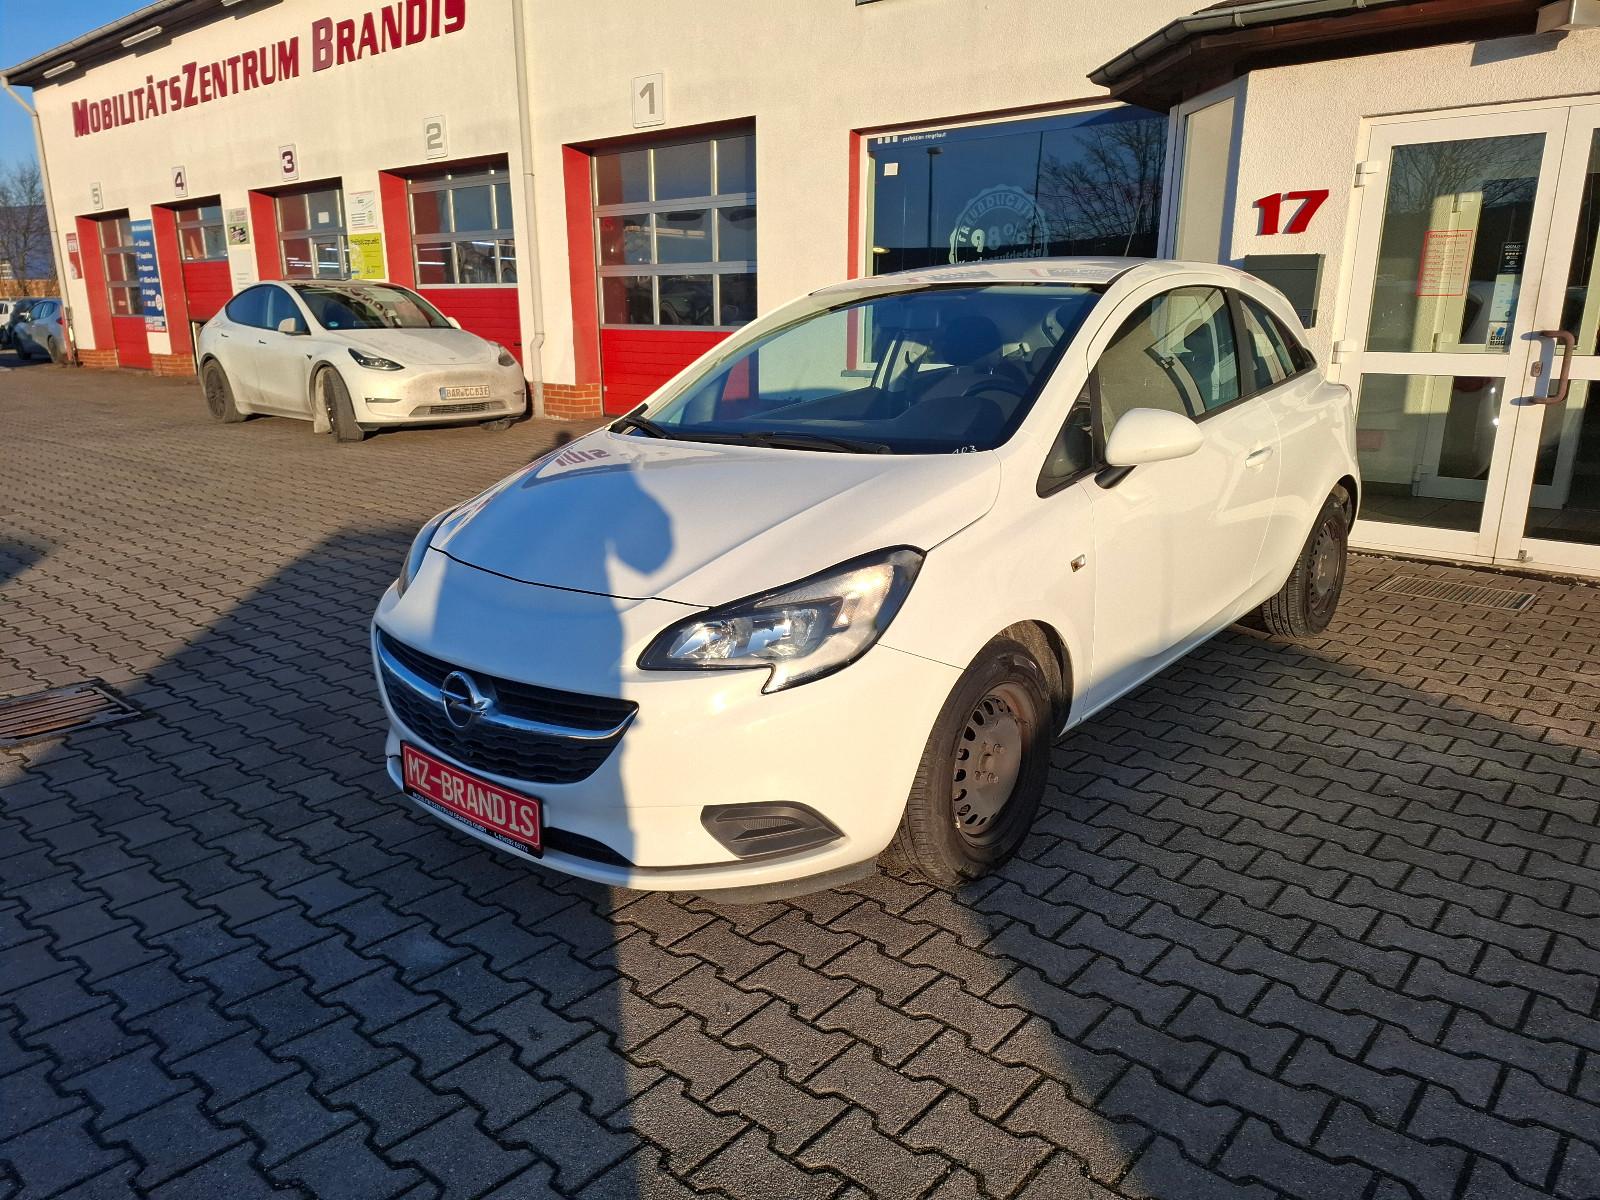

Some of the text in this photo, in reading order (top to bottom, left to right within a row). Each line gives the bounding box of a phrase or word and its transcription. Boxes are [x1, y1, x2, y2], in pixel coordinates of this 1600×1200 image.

[311, 0, 466, 73] BRANDIS
[638, 81, 656, 115] 1
[425, 122, 443, 150] 2
[281, 150, 296, 174] 3
[91, 186, 100, 204] 5
[173, 170, 185, 191] 4
[1252, 188, 1330, 237] 17
[408, 753, 535, 837] MZ-BRANDIS
